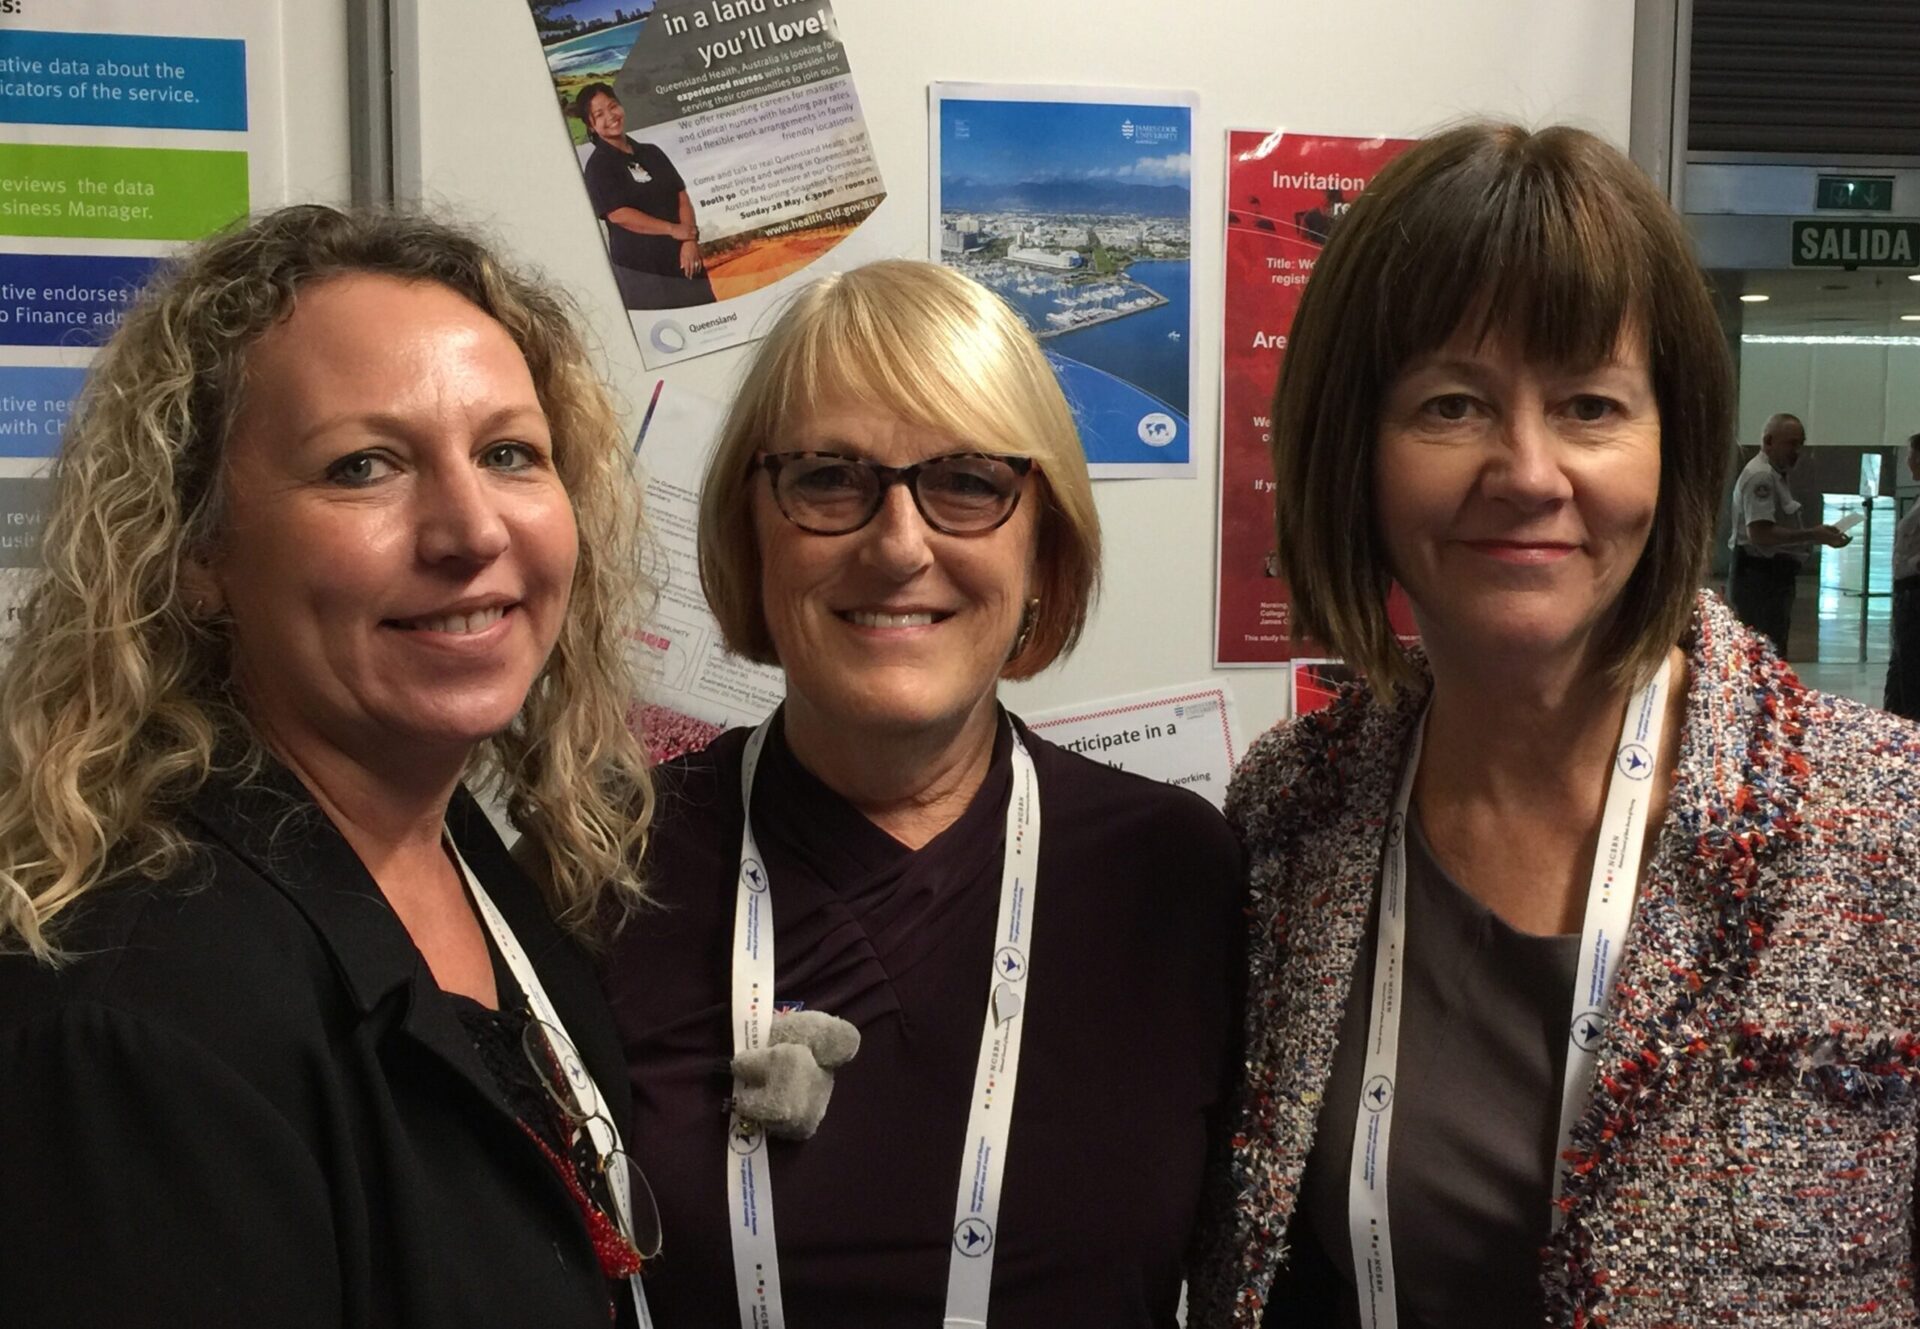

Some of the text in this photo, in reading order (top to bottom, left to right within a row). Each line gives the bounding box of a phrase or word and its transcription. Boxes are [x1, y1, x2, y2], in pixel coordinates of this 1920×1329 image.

[0, 0, 21, 14] s:
[663, 13, 688, 36] in
[694, 10, 709, 28] a
[712, 0, 766, 23] land
[768, 7, 828, 44] love!
[49, 58, 89, 76] data
[96, 60, 150, 78] about
[156, 62, 185, 79] the
[655, 73, 707, 96] Queensland
[741, 53, 778, 71] Australia
[780, 51, 788, 60] is
[790, 42, 821, 59] looking
[823, 38, 834, 48] for
[677, 80, 731, 103] experienced
[733, 73, 763, 86] nurses
[764, 66, 782, 77] with
[792, 55, 824, 72] passion
[826, 50, 839, 60] for
[69, 82, 87, 99] of
[93, 82, 122, 100] the
[128, 86, 199, 103] service.
[682, 99, 713, 114] serving
[715, 92, 734, 104] their
[737, 77, 790, 98] communities
[792, 75, 800, 83] to
[802, 69, 819, 82] join
[678, 79, 847, 130] We offer rewarding careers for managers
[678, 90, 849, 142] and clinical nurses with leading pay rates
[685, 144, 701, 154] and
[703, 134, 734, 149] flexible
[736, 128, 756, 140] work
[758, 112, 816, 135] arrangements
[827, 102, 853, 116] family
[782, 125, 814, 141] friendly
[717, 169, 731, 179] and
[749, 162, 756, 170] to
[775, 145, 820, 164] Queensland
[78, 178, 107, 194] the
[114, 179, 155, 196] data
[711, 180, 732, 192] about
[734, 174, 755, 187] living
[759, 170, 771, 179] and
[773, 161, 803, 176] working
[1272, 170, 1365, 191] Invitation
[699, 194, 723, 207] Booth
[740, 205, 769, 220] Sunday
[845, 180, 864, 190] room
[760, 188, 789, 203] Nursing
[68, 201, 153, 222] Manager.
[1801, 227, 1912, 260] SALIDA
[1266, 257, 1295, 269] Title:
[43, 285, 128, 302] endorses
[16, 307, 87, 324] Finance
[689, 312, 738, 333] Queensland
[1253, 331, 1287, 349] Are
[0, 396, 37, 412] tive
[0, 418, 37, 435] with
[1254, 479, 1263, 490] If
[1260, 618, 1282, 626] James
[1260, 634, 1279, 643] study
[1145, 724, 1162, 740] in
[1166, 722, 1177, 735] a
[1172, 771, 1211, 787] working
